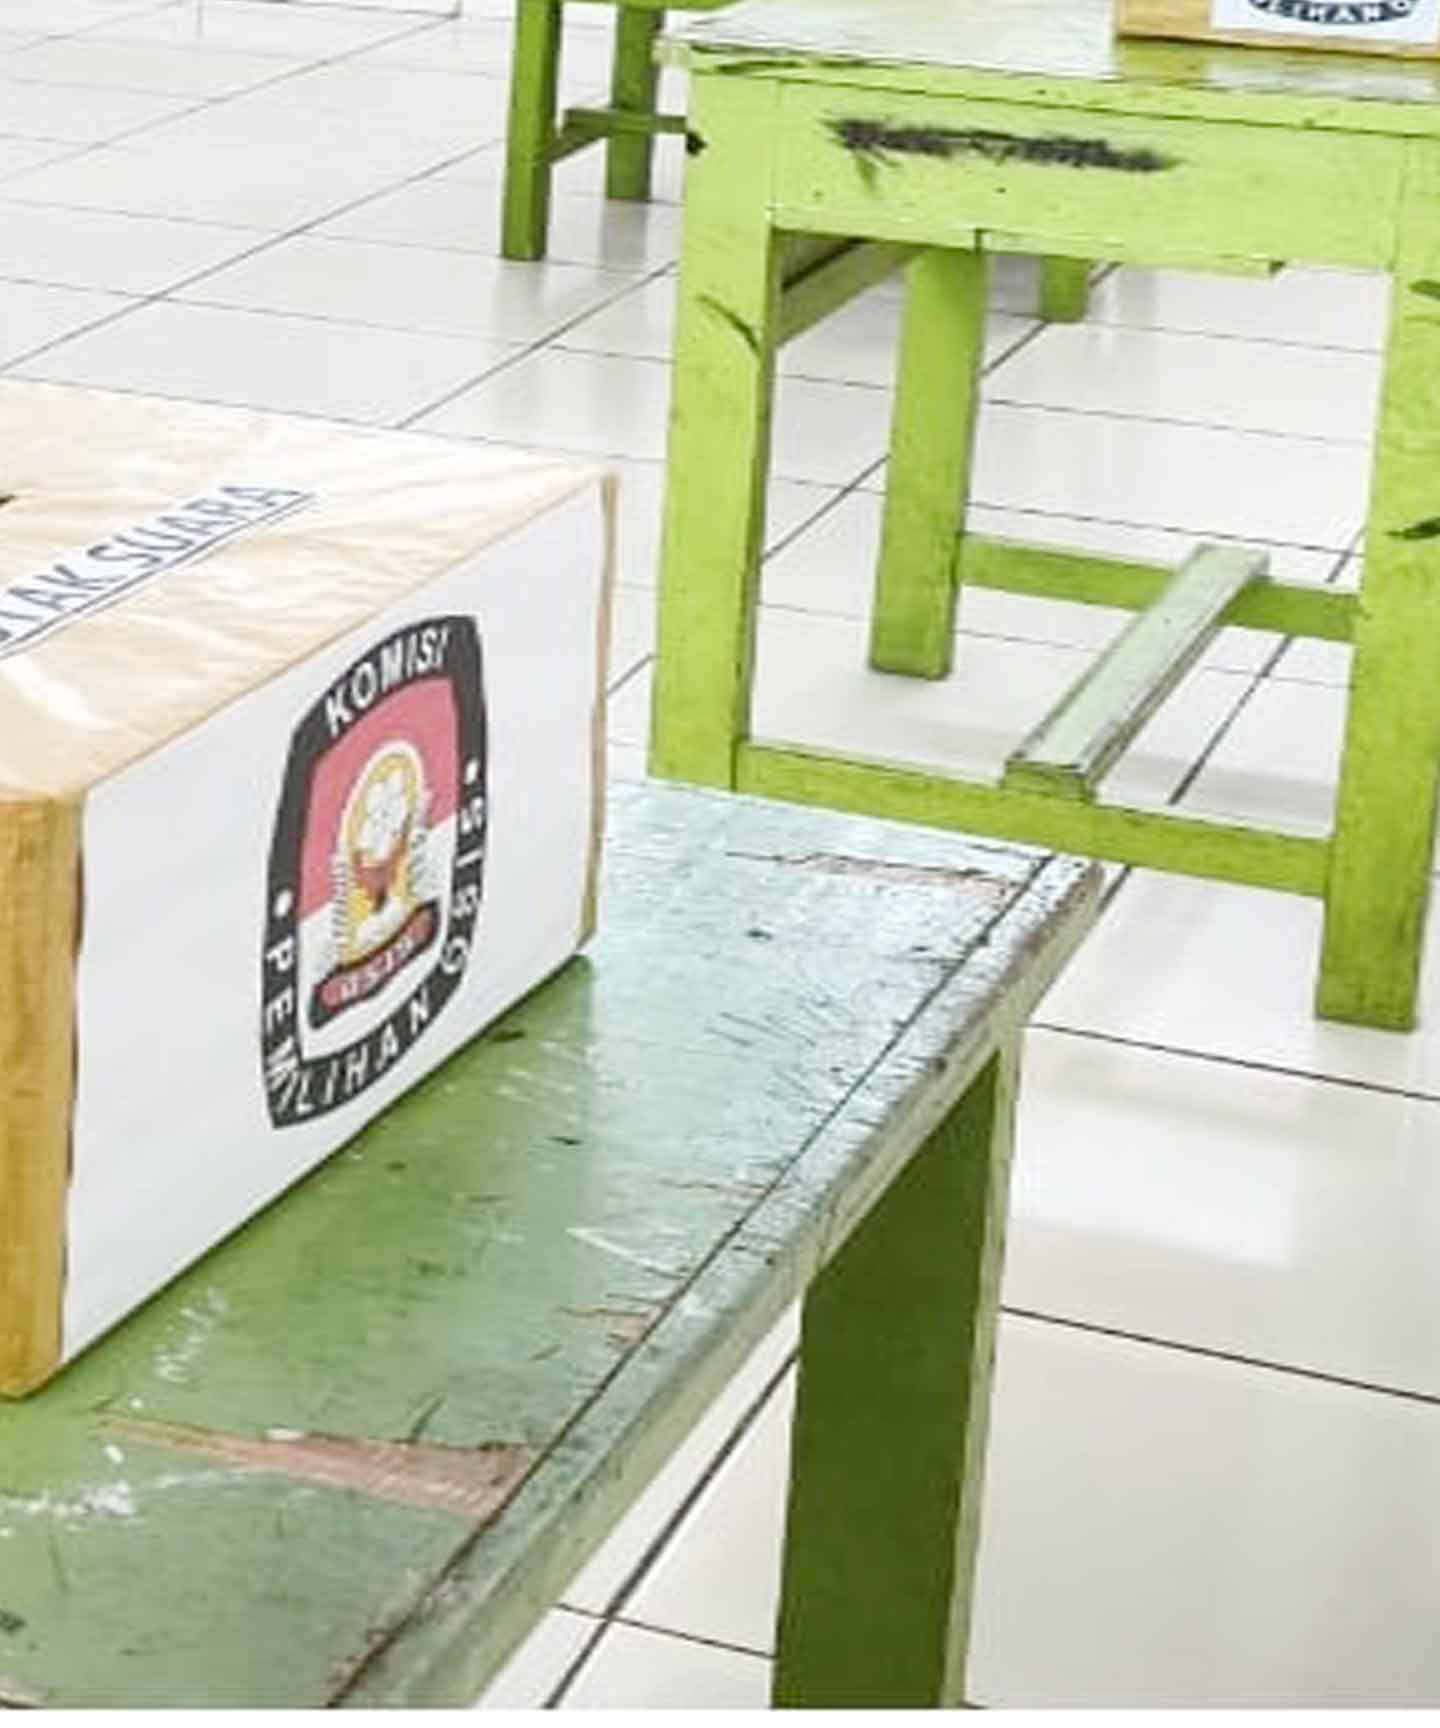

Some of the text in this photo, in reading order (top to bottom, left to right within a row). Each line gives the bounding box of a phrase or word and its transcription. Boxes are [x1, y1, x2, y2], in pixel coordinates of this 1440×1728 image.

[86, 484, 304, 569] SUARA
[325, 624, 449, 735] KOMISI
[265, 947, 431, 1114] PEMILIHAN
